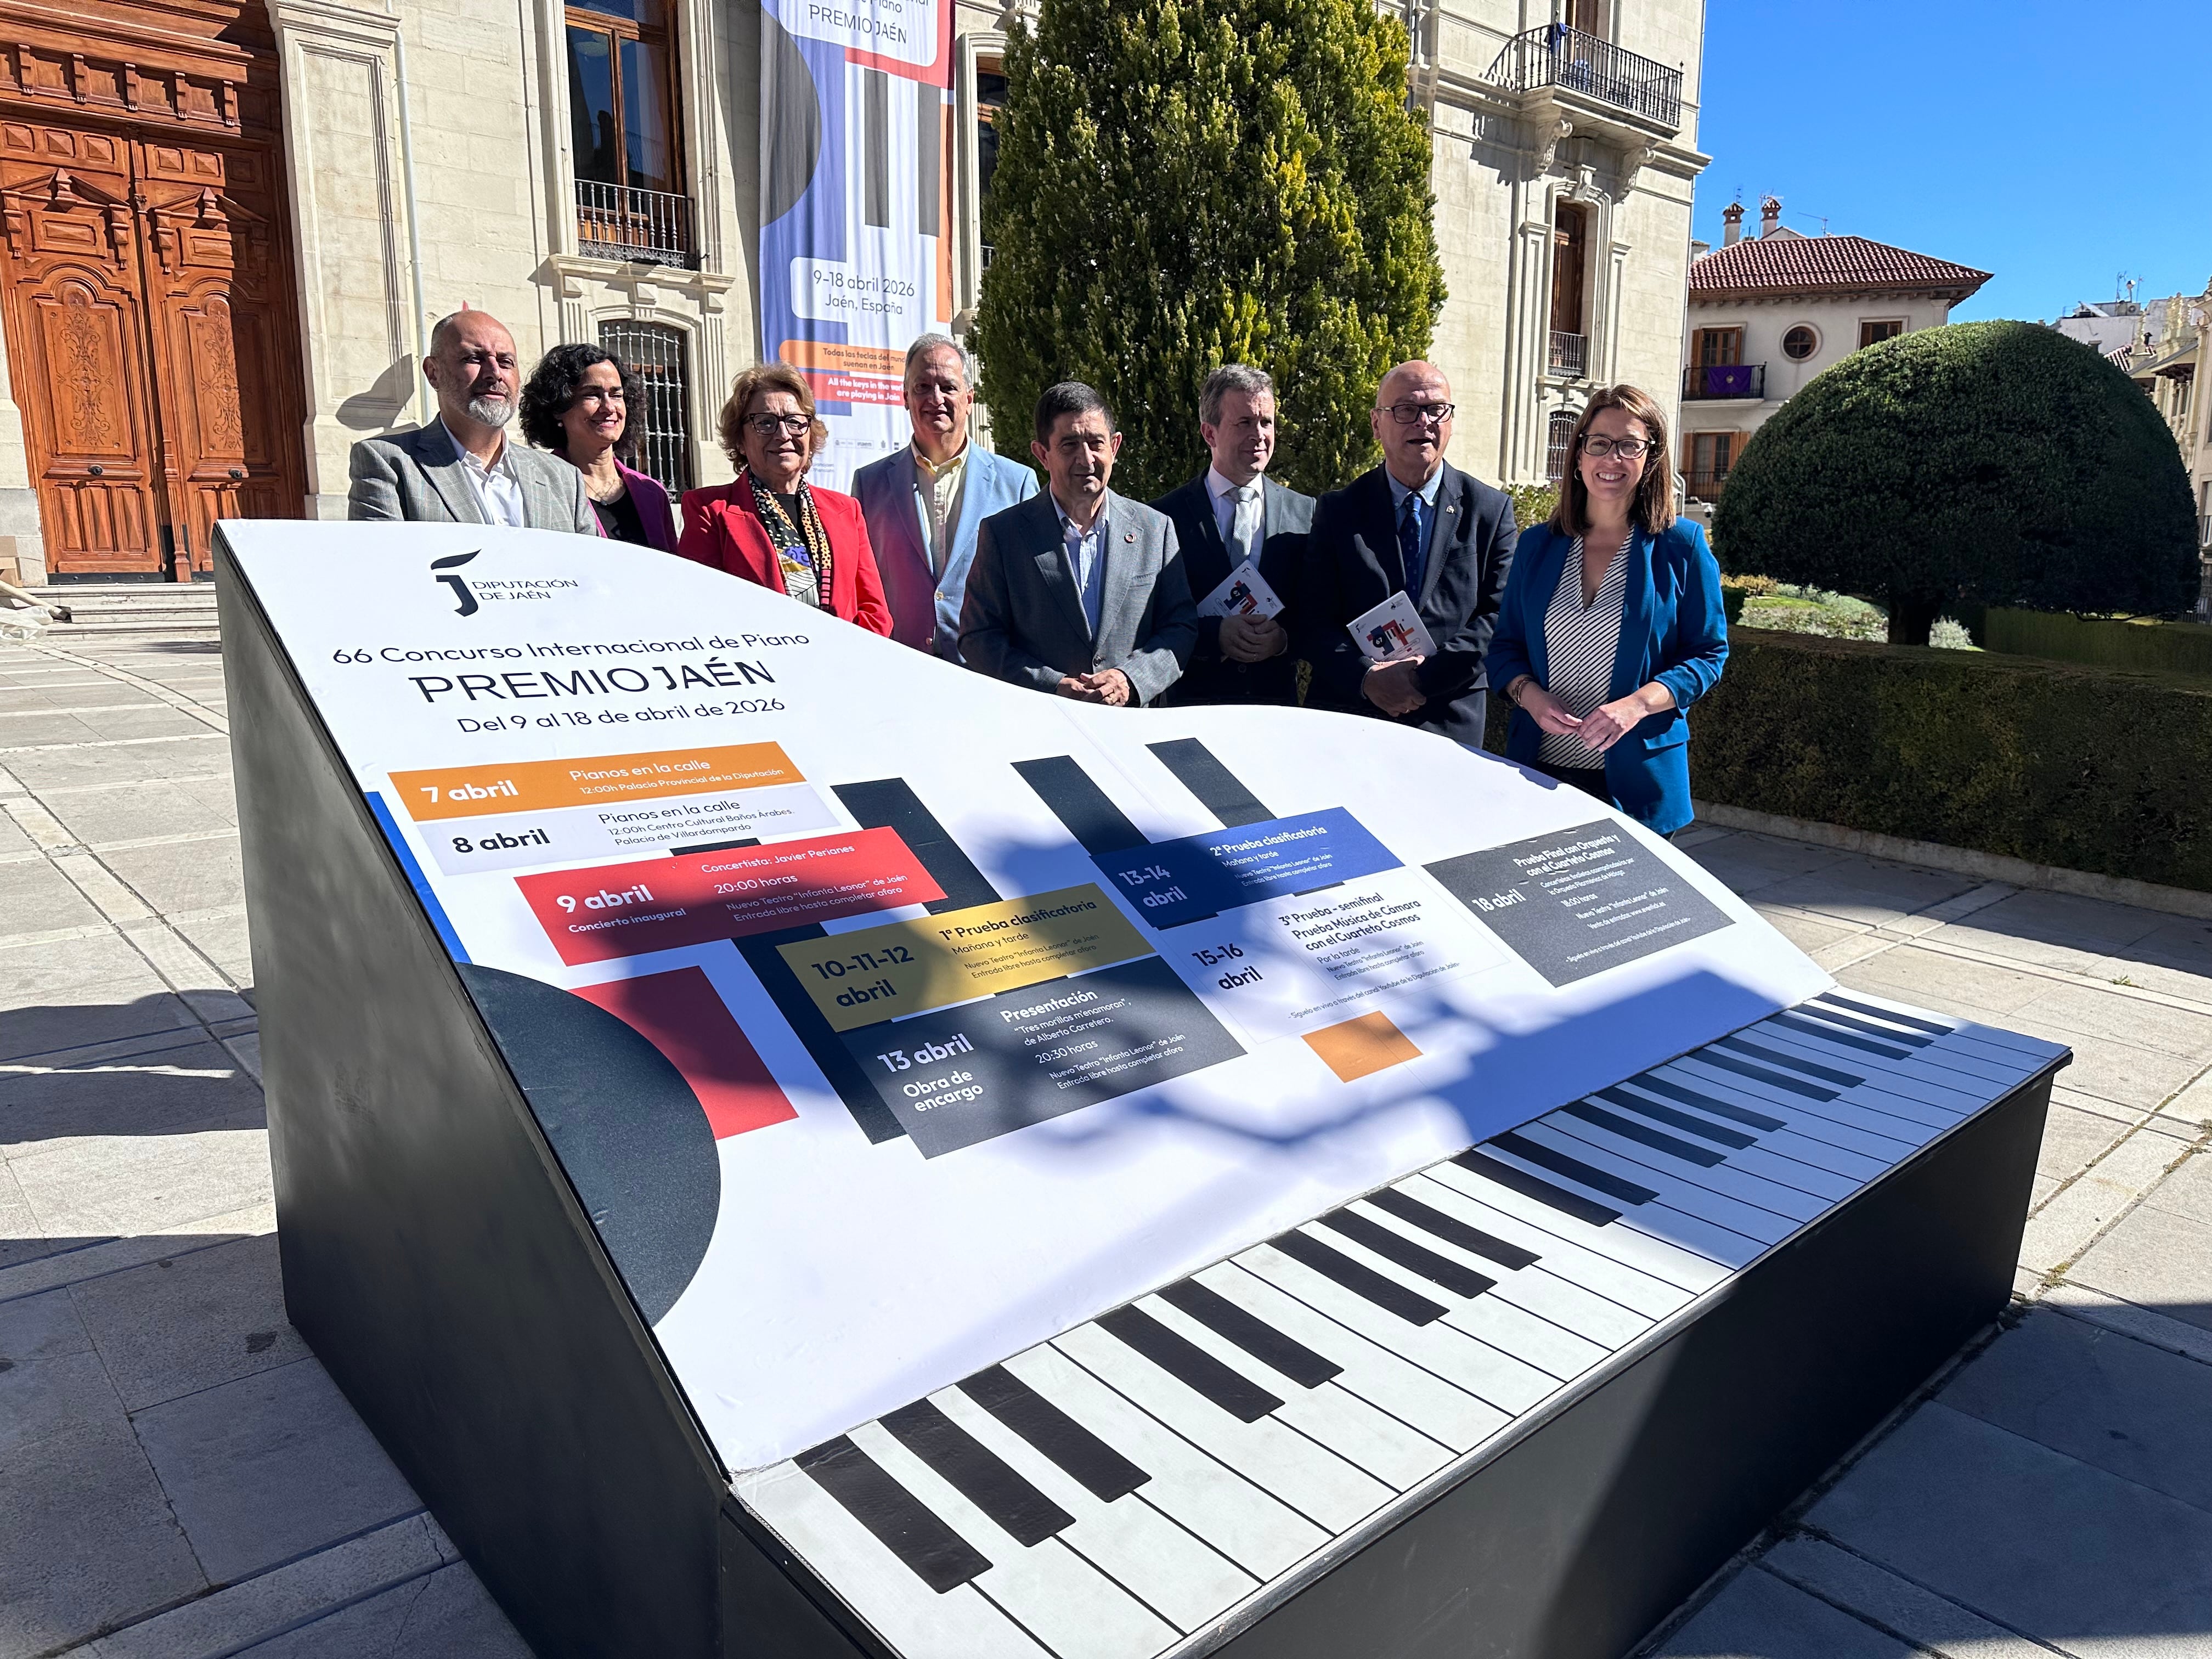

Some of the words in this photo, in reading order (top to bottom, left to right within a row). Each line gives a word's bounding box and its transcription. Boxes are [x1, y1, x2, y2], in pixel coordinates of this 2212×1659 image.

[809, 4, 872, 33] PREMIO
[876, 21, 906, 44] JAÉN
[814, 270, 844, 287] 9-18
[847, 275, 878, 292] abril
[883, 279, 915, 297] 2026
[825, 294, 857, 312] Jaén,
[861, 298, 902, 314] España
[823, 348, 844, 357] Todas
[845, 349, 855, 358] las
[856, 351, 877, 360] teclas
[827, 377, 839, 386] All
[839, 378, 852, 387] the
[853, 379, 870, 390] keys
[870, 381, 877, 389] in
[877, 381, 889, 390] the
[890, 383, 904, 392] worl
[850, 390, 877, 401] playing
[471, 579, 578, 589] DIPUTACIÓN
[509, 590, 551, 599] JAÉN
[332, 648, 373, 664] 66
[380, 647, 522, 662] Concurso
[526, 636, 704, 657] Internacional
[708, 635, 740, 649] de
[740, 634, 809, 647] Piano
[408, 668, 649, 703] PREMIO
[651, 656, 776, 690] JAÉN
[456, 716, 506, 732] Del
[510, 715, 526, 729] 9
[536, 713, 560, 727] al
[561, 711, 592, 725] 18
[597, 709, 629, 723] de
[635, 704, 690, 721] abril
[694, 703, 724, 716] de
[725, 698, 785, 714] 2026
[569, 769, 629, 781] Pianos
[631, 766, 653, 775] en
[652, 763, 671, 772] la
[673, 760, 710, 771] calle
[579, 785, 618, 794] 12:00h
[618, 781, 657, 791] Palacio
[657, 776, 708, 786] Provincial
[732, 769, 784, 779] Diputación
[420, 786, 438, 803] 7
[448, 779, 518, 800] abril
[597, 811, 658, 823] Pianos
[661, 809, 682, 817] en
[682, 805, 701, 814] la
[703, 800, 740, 812] calle
[606, 825, 646, 836] 12:00h
[646, 822, 684, 831] Centro
[684, 815, 725, 826] Cultural
[725, 813, 757, 822] Baños
[452, 837, 473, 853] 8
[479, 828, 550, 850] abril
[614, 837, 655, 845] Palacio
[671, 823, 751, 838] Villardompardo
[1221, 839, 1264, 854] Prueba
[1262, 826, 1328, 845] clasificatoria
[701, 858, 772, 872] Concertista:
[774, 853, 806, 863] Javier
[807, 845, 855, 857] Perianes
[1512, 854, 1547, 867] Prueba
[1541, 847, 1567, 859] Final
[1564, 845, 1581, 854] con
[1576, 835, 1615, 850] Orquesta
[1611, 834, 1621, 843] y
[714, 879, 758, 894] 20:00
[758, 875, 798, 887] horas
[1118, 865, 1171, 885] 13-14
[556, 895, 576, 913] 9
[584, 884, 654, 909] abril
[725, 901, 759, 911] Nuevo
[759, 895, 793, 904] Teatro
[886, 874, 907, 883] Jaén
[733, 909, 776, 921] Entrada
[799, 900, 828, 910] hasta
[829, 891, 874, 905] completar
[877, 887, 902, 896] aforo
[1143, 885, 1187, 907] abril
[1471, 897, 1494, 912] 18
[1491, 888, 1526, 908] abril
[568, 918, 629, 933] Concierto
[629, 907, 686, 923] inaugural
[953, 920, 1009, 938] Prueba
[1009, 900, 1097, 926] clasificatoria
[1290, 907, 1333, 922] Prueba
[1338, 892, 1384, 911] semifinal
[1291, 924, 1334, 939] Prueba
[1329, 915, 1369, 928] Música
[1368, 910, 1383, 919] de
[1380, 900, 1421, 915] Cámara
[951, 941, 995, 955] Mañana
[1001, 932, 1029, 943] tarde
[1305, 940, 1327, 950] con
[1325, 934, 1338, 945] el
[1334, 924, 1382, 941] Cuarteto
[1380, 914, 1420, 928] Cosmos
[810, 946, 915, 979] 10-11-12
[1191, 943, 1244, 966] 15-16
[1218, 965, 1263, 989] abril
[836, 978, 897, 1007] abril
[999, 990, 1098, 1023] Presentación
[1024, 1037, 1036, 1046] de
[1036, 1029, 1069, 1042] Alberto
[1069, 1017, 1114, 1032] Carretero.
[1039, 1014, 1074, 1029] morillas
[876, 1049, 911, 1072] 13
[913, 1032, 974, 1064] abril
[1035, 1047, 1068, 1063] 20:30
[1066, 1041, 1098, 1054] horas
[1048, 1068, 1075, 1079] Nuevo
[1073, 1060, 1100, 1071] Teatro
[1167, 1034, 1186, 1043] Jaén
[1056, 1075, 1090, 1089] Entrada
[1087, 1070, 1107, 1079] libre
[1104, 1063, 1128, 1074] hasta
[1127, 1052, 1163, 1067] completar
[1163, 1046, 1183, 1056] aforo
[902, 1077, 951, 1097] Obra
[950, 1070, 973, 1084] de
[914, 1085, 983, 1111] encargo
